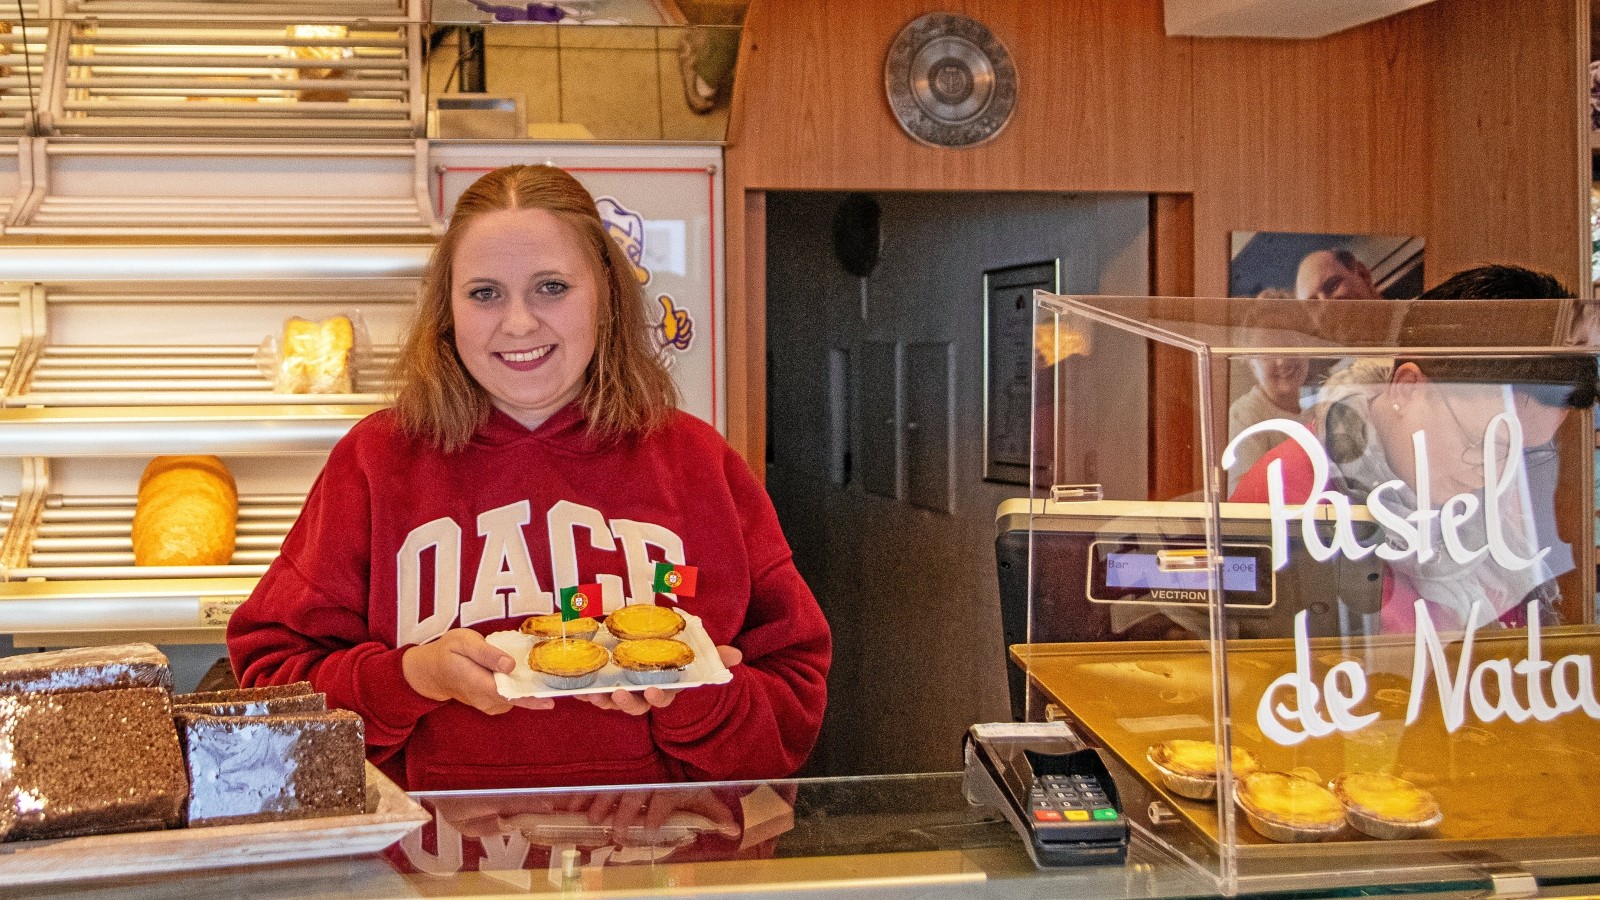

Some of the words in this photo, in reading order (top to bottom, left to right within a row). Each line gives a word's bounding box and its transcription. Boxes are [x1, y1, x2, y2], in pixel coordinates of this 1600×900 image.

[1221, 412, 1552, 572] Pastel
[1108, 559, 1129, 570] Bar
[1221, 563, 1255, 573] ,00€
[1151, 590, 1207, 601] VECTRON
[1256, 608, 1382, 746] de
[1403, 598, 1600, 733] Nata
